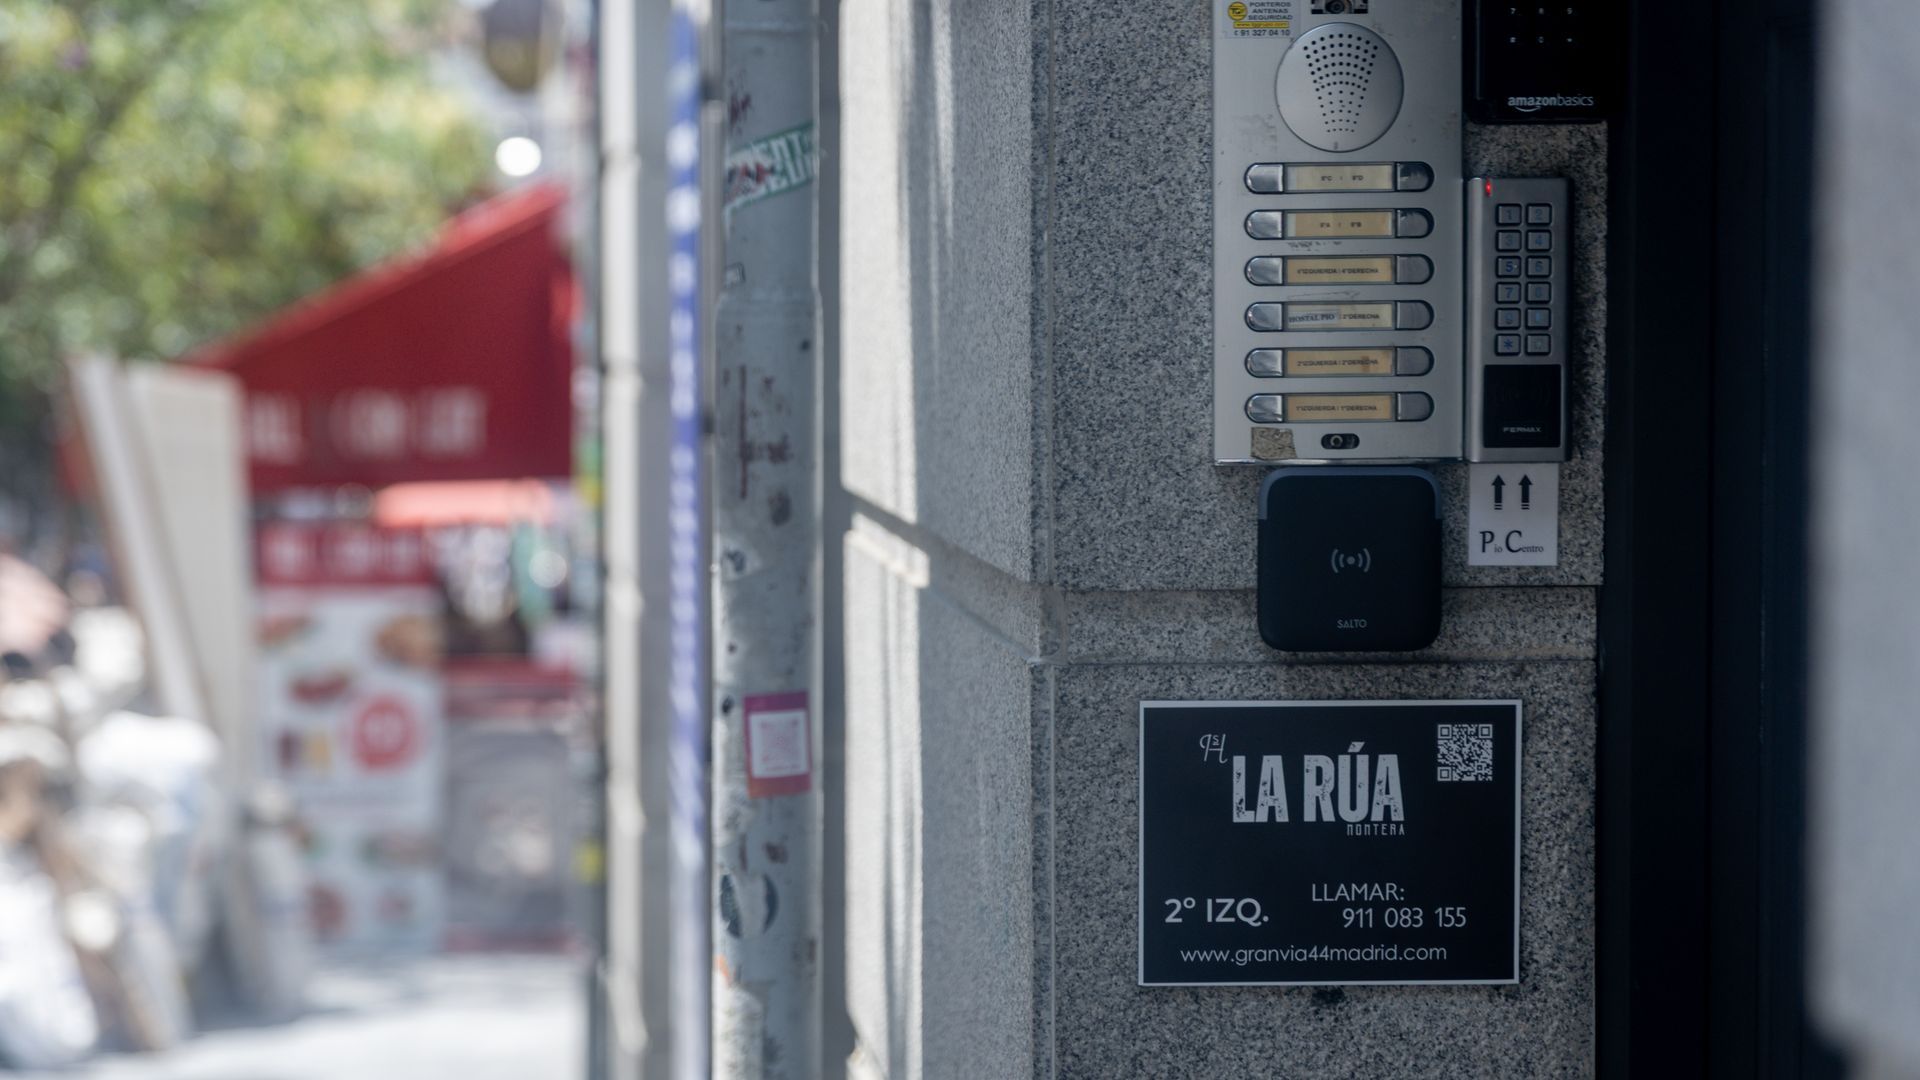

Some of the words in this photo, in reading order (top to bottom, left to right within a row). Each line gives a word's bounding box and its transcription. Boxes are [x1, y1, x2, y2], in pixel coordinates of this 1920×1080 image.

[1507, 93, 1594, 109] amazonbasics
[1505, 261, 1514, 273] 5
[1505, 287, 1514, 299] 7
[1505, 530, 1544, 553] Centro
[1336, 619, 1367, 629] SALTO
[1233, 755, 1288, 823] LA
[1303, 742, 1405, 823] RÚA
[1312, 882, 1405, 902] LLAMAR:
[1165, 897, 1196, 923] 2º
[1206, 898, 1269, 927] IZQ.
[1342, 907, 1374, 929] 911
[1384, 907, 1424, 928] 083
[1434, 907, 1467, 928] 155
[1180, 944, 1448, 967] www.granvia44madrid.com
